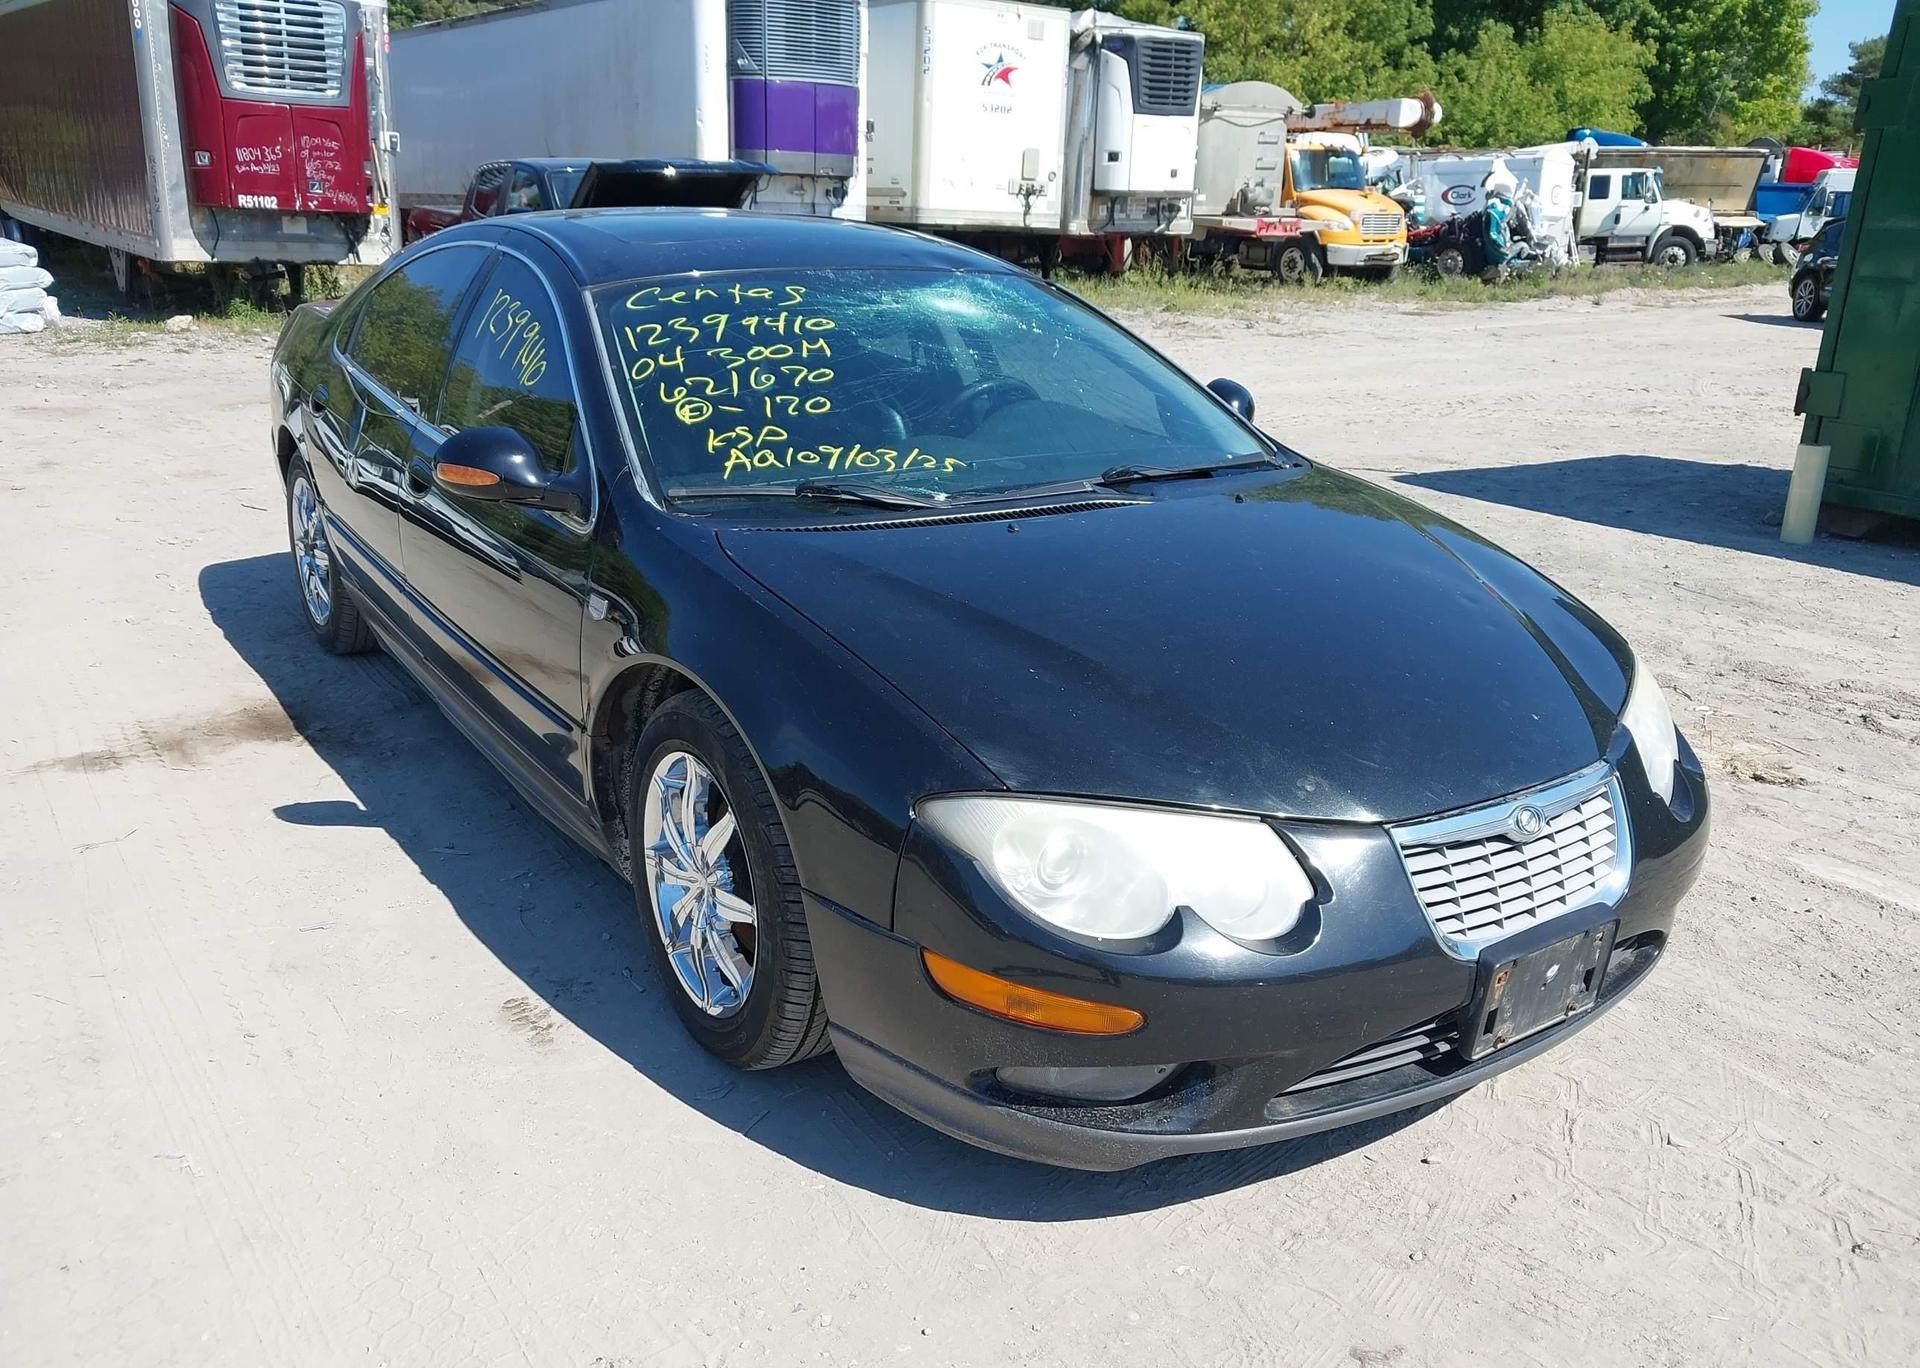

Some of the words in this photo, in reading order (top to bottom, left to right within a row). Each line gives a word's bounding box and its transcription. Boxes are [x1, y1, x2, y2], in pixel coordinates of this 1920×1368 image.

[237, 194, 279, 209] R51102
[631, 345, 686, 380] 04
[706, 337, 832, 369] 300M
